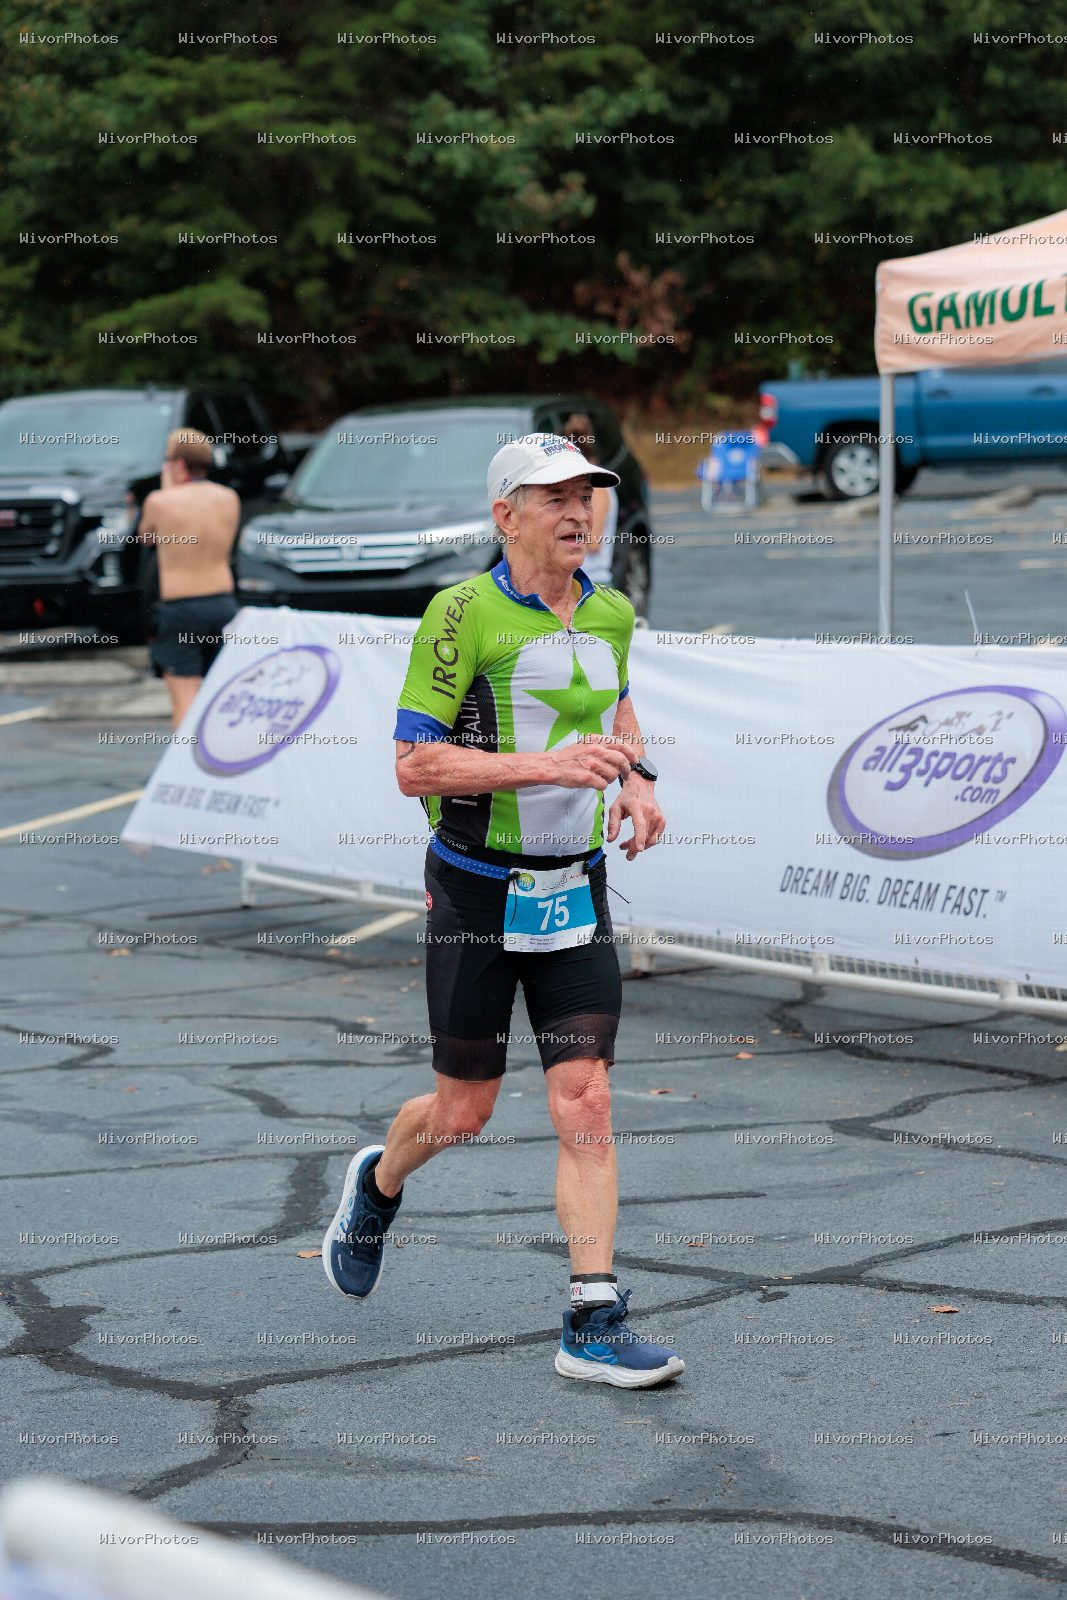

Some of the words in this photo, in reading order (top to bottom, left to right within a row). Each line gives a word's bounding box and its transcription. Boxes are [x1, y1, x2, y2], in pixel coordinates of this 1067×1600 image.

[908, 273, 1067, 334] GAMUL
[537, 895, 570, 931] 75
[779, 864, 839, 900] DREAM
[840, 872, 870, 903] BIG.
[877, 876, 940, 913] DREAM
